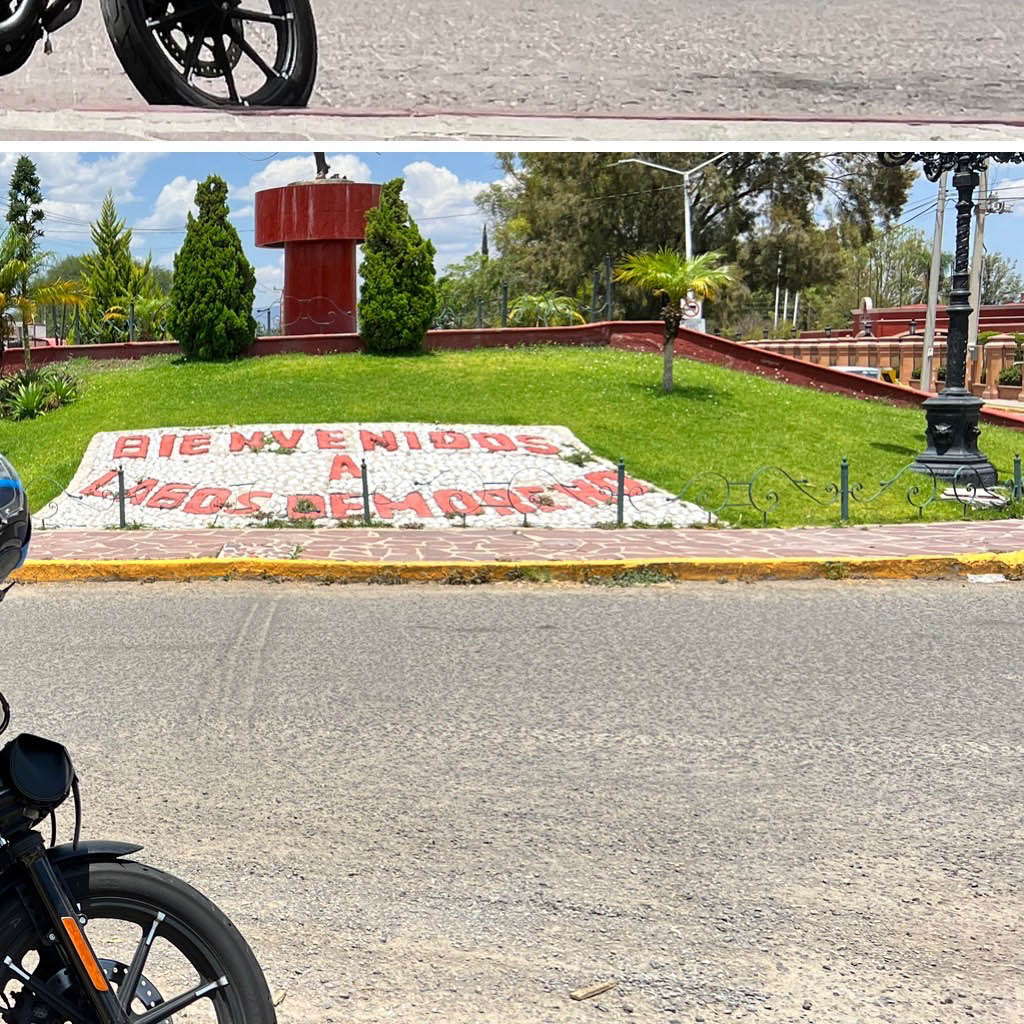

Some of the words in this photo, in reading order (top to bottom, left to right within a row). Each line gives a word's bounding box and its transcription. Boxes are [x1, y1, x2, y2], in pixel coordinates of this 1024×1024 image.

[112, 429, 560, 459] BIENVENIDOS
[329, 454, 362, 480] A
[79, 469, 272, 516] LAGOS
